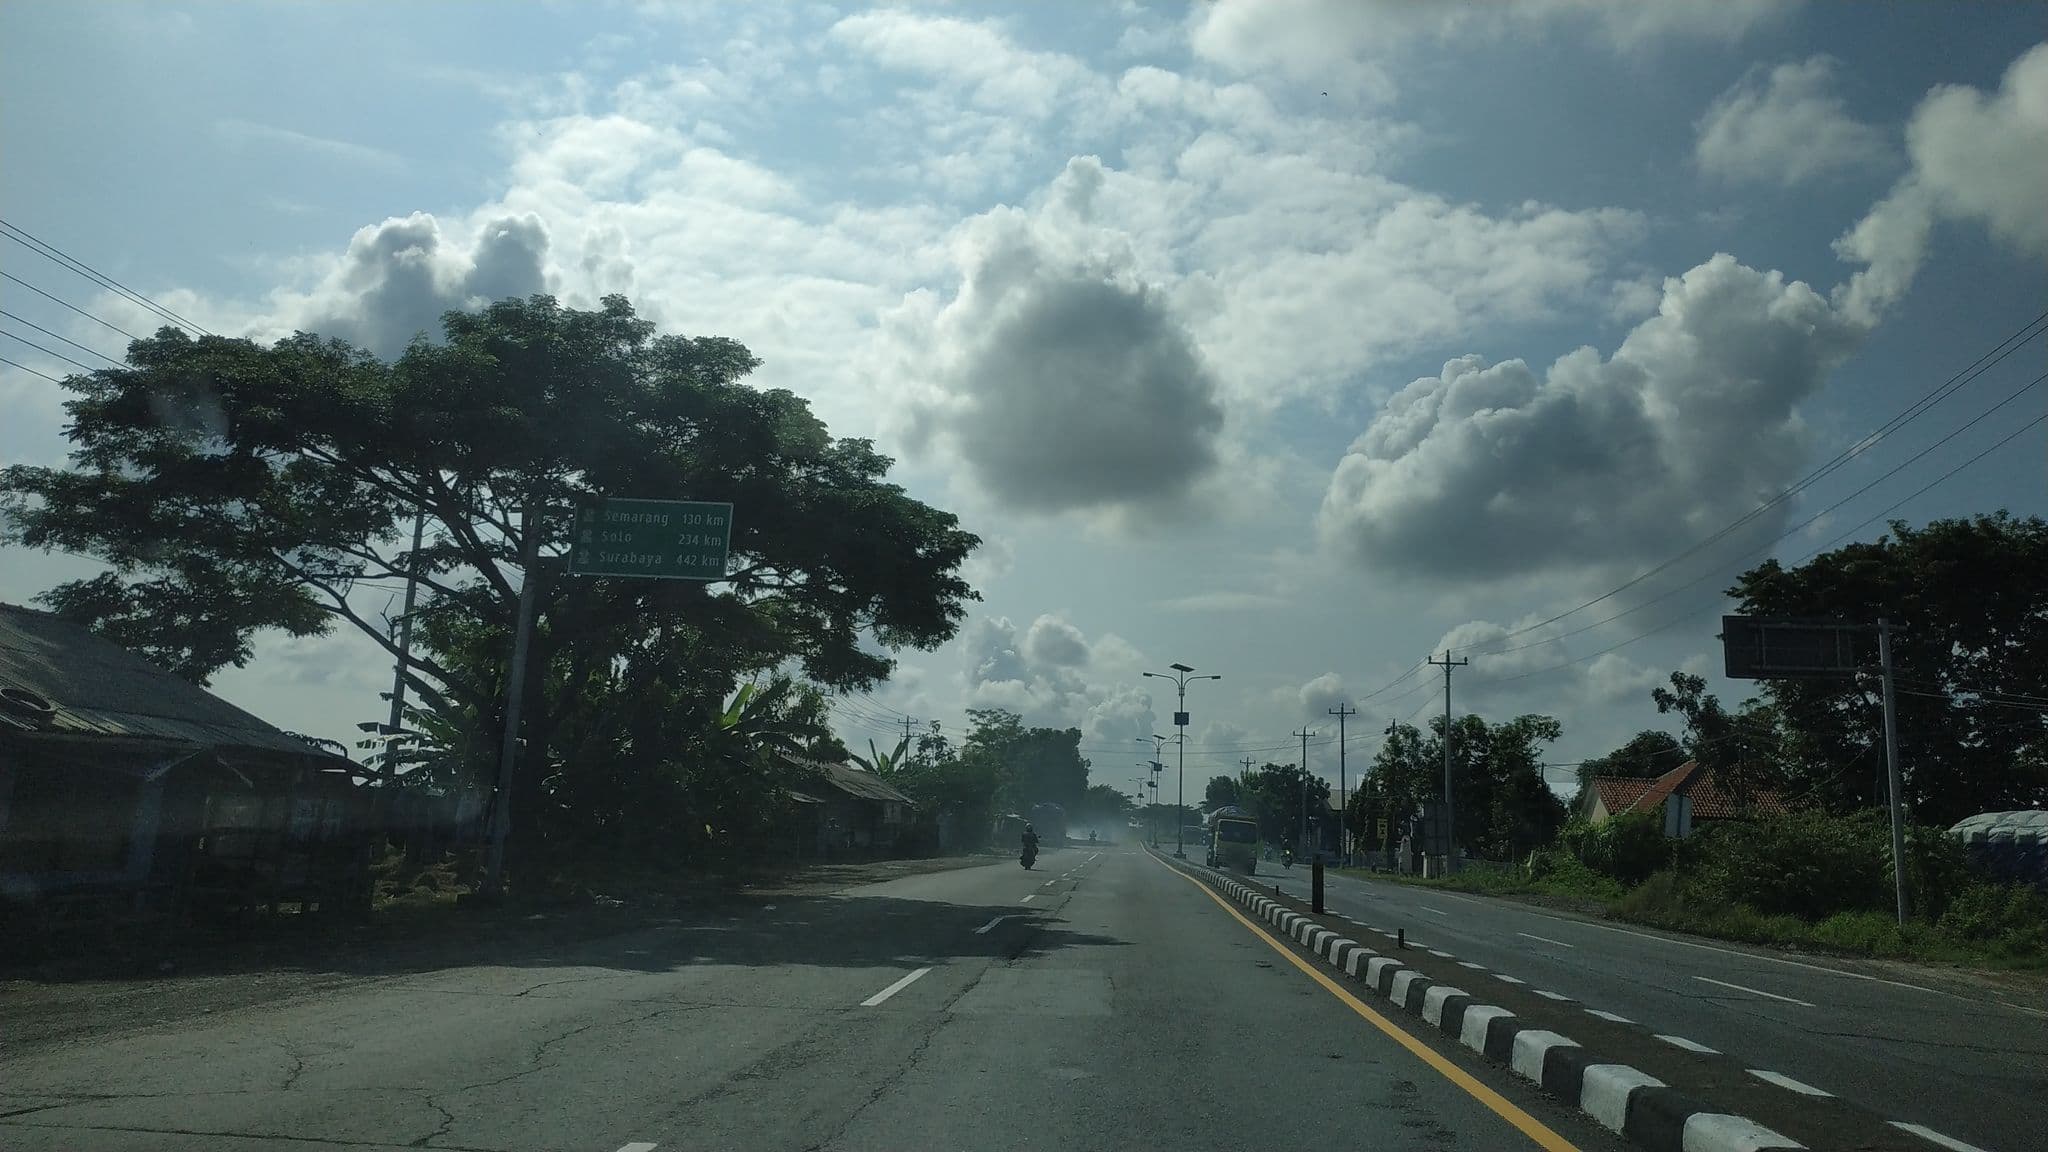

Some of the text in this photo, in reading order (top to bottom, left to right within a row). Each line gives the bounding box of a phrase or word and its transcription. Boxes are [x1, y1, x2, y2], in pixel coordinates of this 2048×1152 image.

[605, 510, 724, 527] Semarang 130 km
[601, 530, 721, 546] Solo 234 km
[599, 551, 719, 567] Surabaya 442 km
